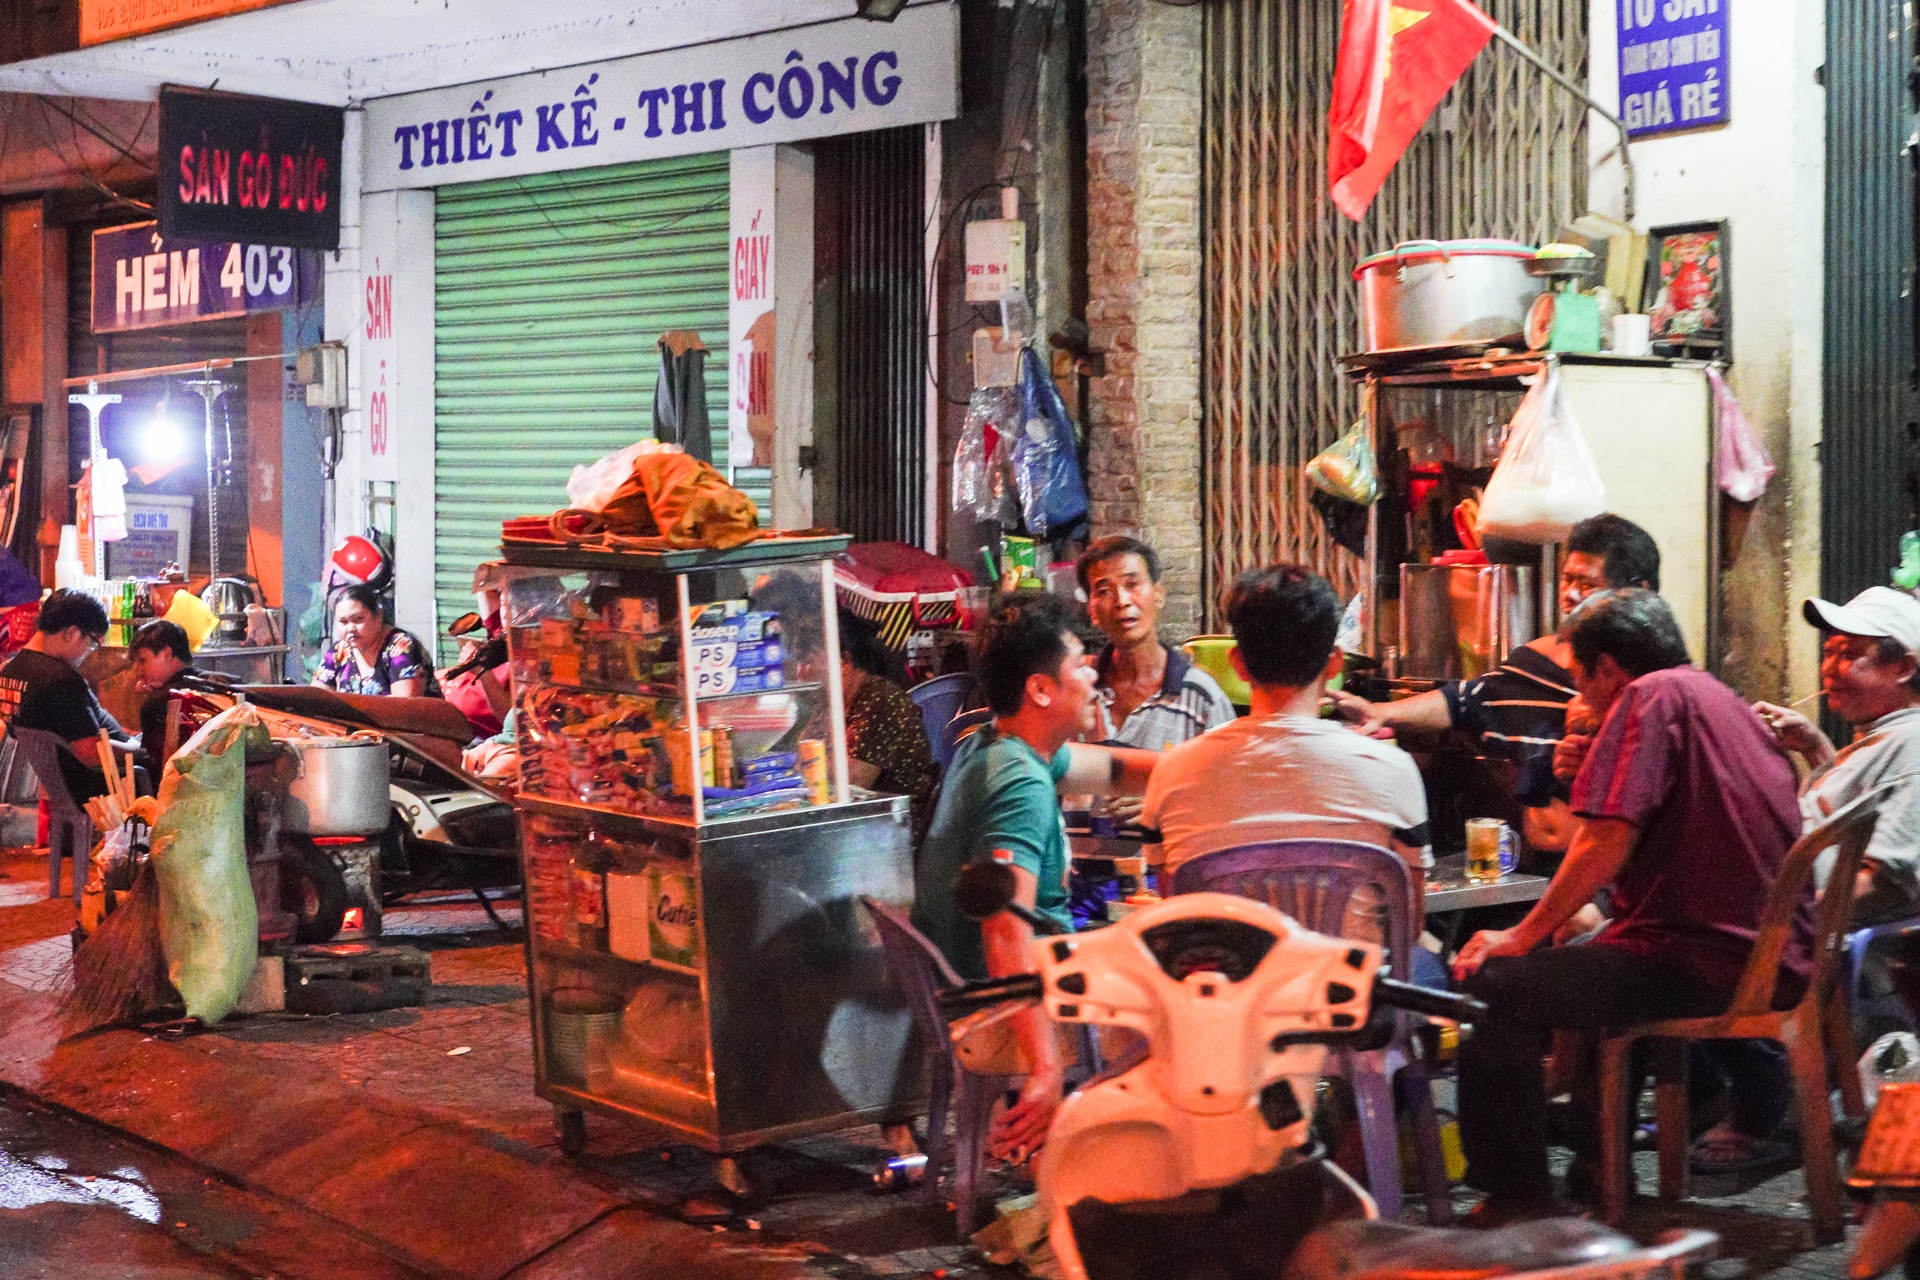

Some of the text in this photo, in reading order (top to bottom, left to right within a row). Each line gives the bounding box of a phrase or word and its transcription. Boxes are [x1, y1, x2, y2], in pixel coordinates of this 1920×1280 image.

[394, 90, 523, 170] THIẾT
[536, 72, 600, 153] KẾ
[638, 78, 727, 138] THI
[742, 50, 903, 124] CÔNG
[1623, 67, 1721, 130] GIÁ RẺ
[115, 232, 293, 314] HẺM 403
[734, 209, 770, 301] GIẤY
[370, 360, 387, 456] GỖ
[699, 672, 724, 689] PS
[700, 646, 724, 662] PS
